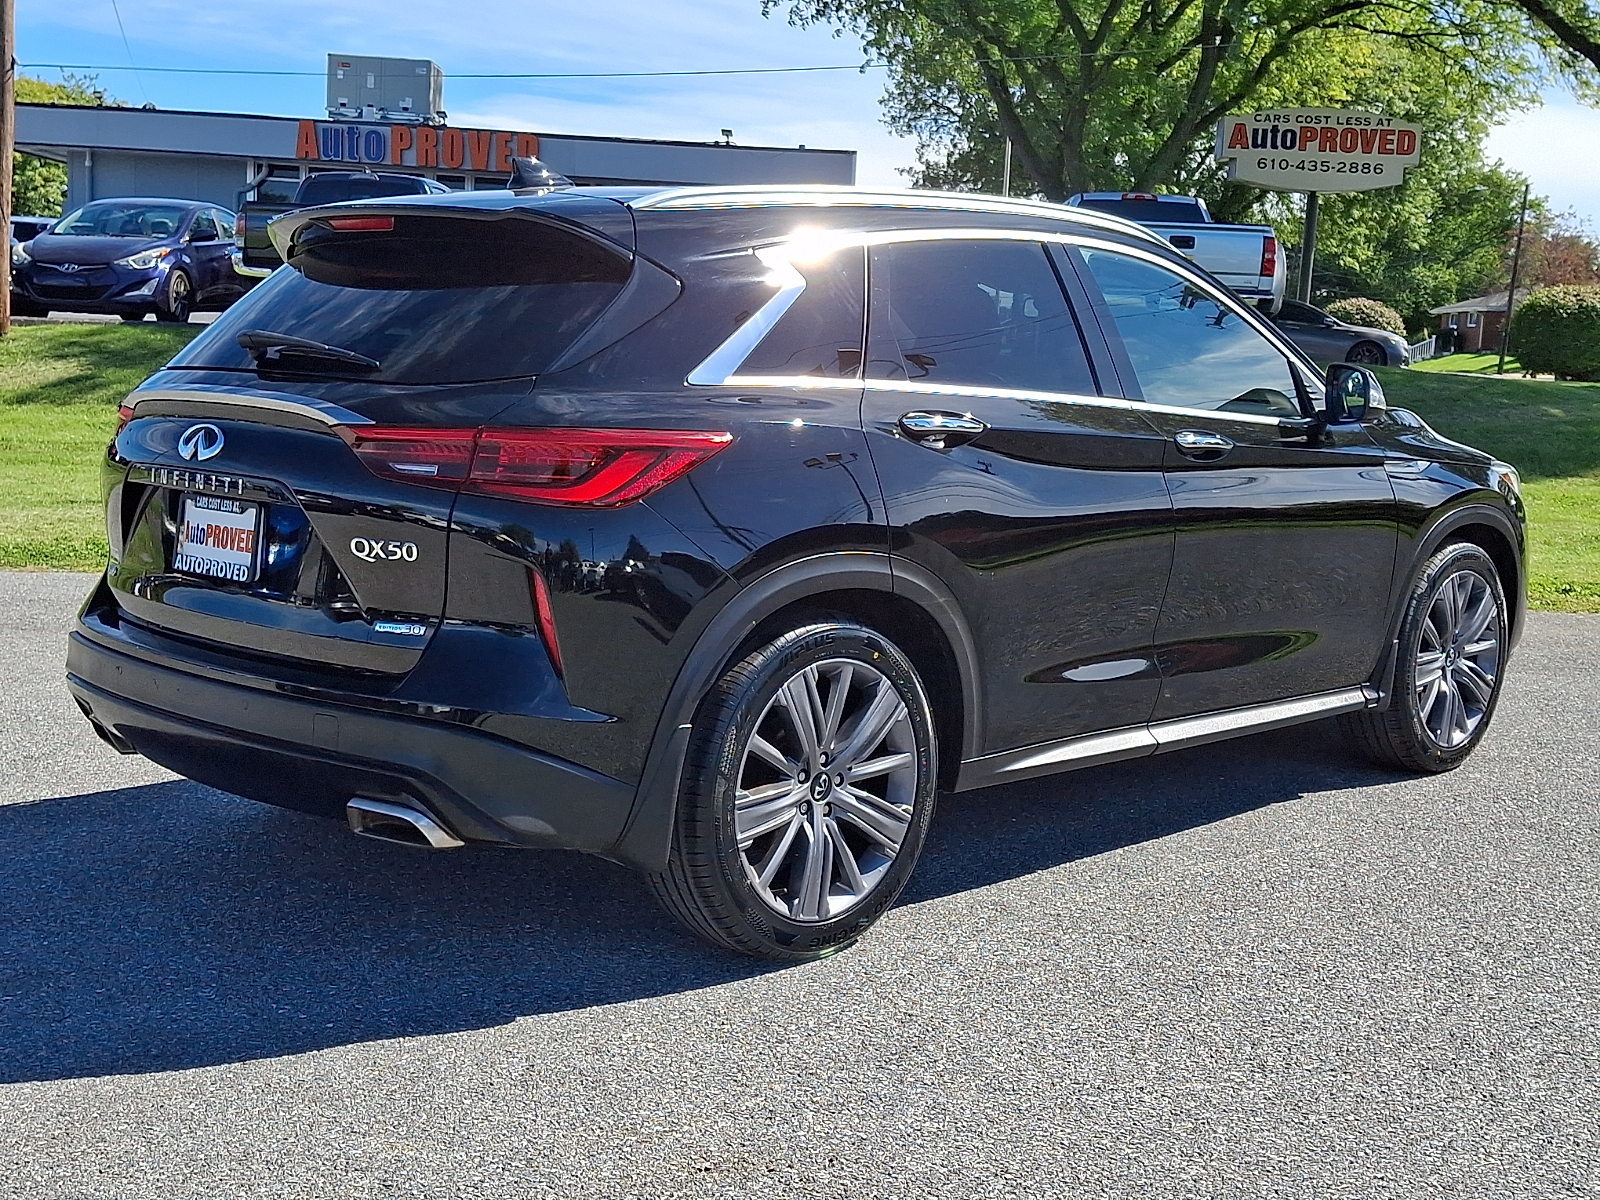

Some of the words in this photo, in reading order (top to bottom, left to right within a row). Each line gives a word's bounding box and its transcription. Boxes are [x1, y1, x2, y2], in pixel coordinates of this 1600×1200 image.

[1254, 114, 1291, 124] CARS
[1296, 115, 1331, 126] COST
[1336, 117, 1372, 127] LESS
[1376, 118, 1393, 128] AT
[1228, 123, 1416, 156] AutoPROVED
[1257, 158, 1384, 175] 610-435-2886
[151, 468, 243, 495] INFINITI
[196, 496, 208, 508] CARS
[209, 497, 220, 510] COST
[220, 499, 232, 512] LESS
[185, 520, 255, 553] AutoPROVED
[350, 537, 418, 563] QX50
[175, 554, 249, 581] AUTOPROVED
